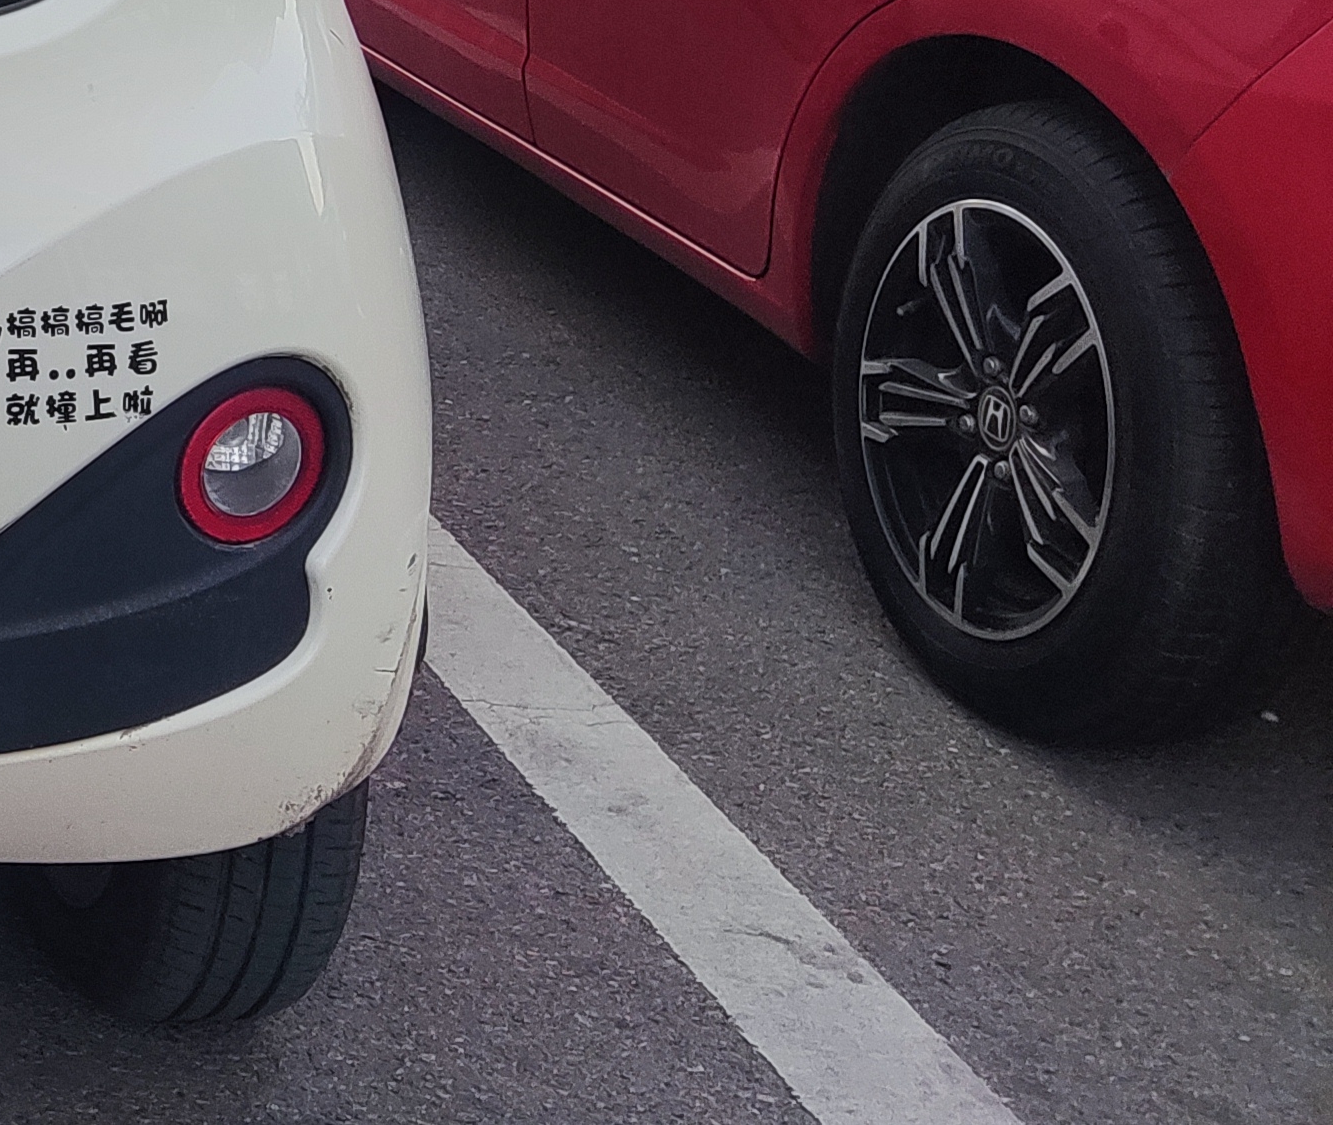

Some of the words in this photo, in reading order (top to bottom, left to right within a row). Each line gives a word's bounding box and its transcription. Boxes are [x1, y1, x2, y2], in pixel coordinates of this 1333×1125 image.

[6, 299, 169, 338] 搞搞搞毛啊
[6, 386, 154, 426] 就撞上啦
